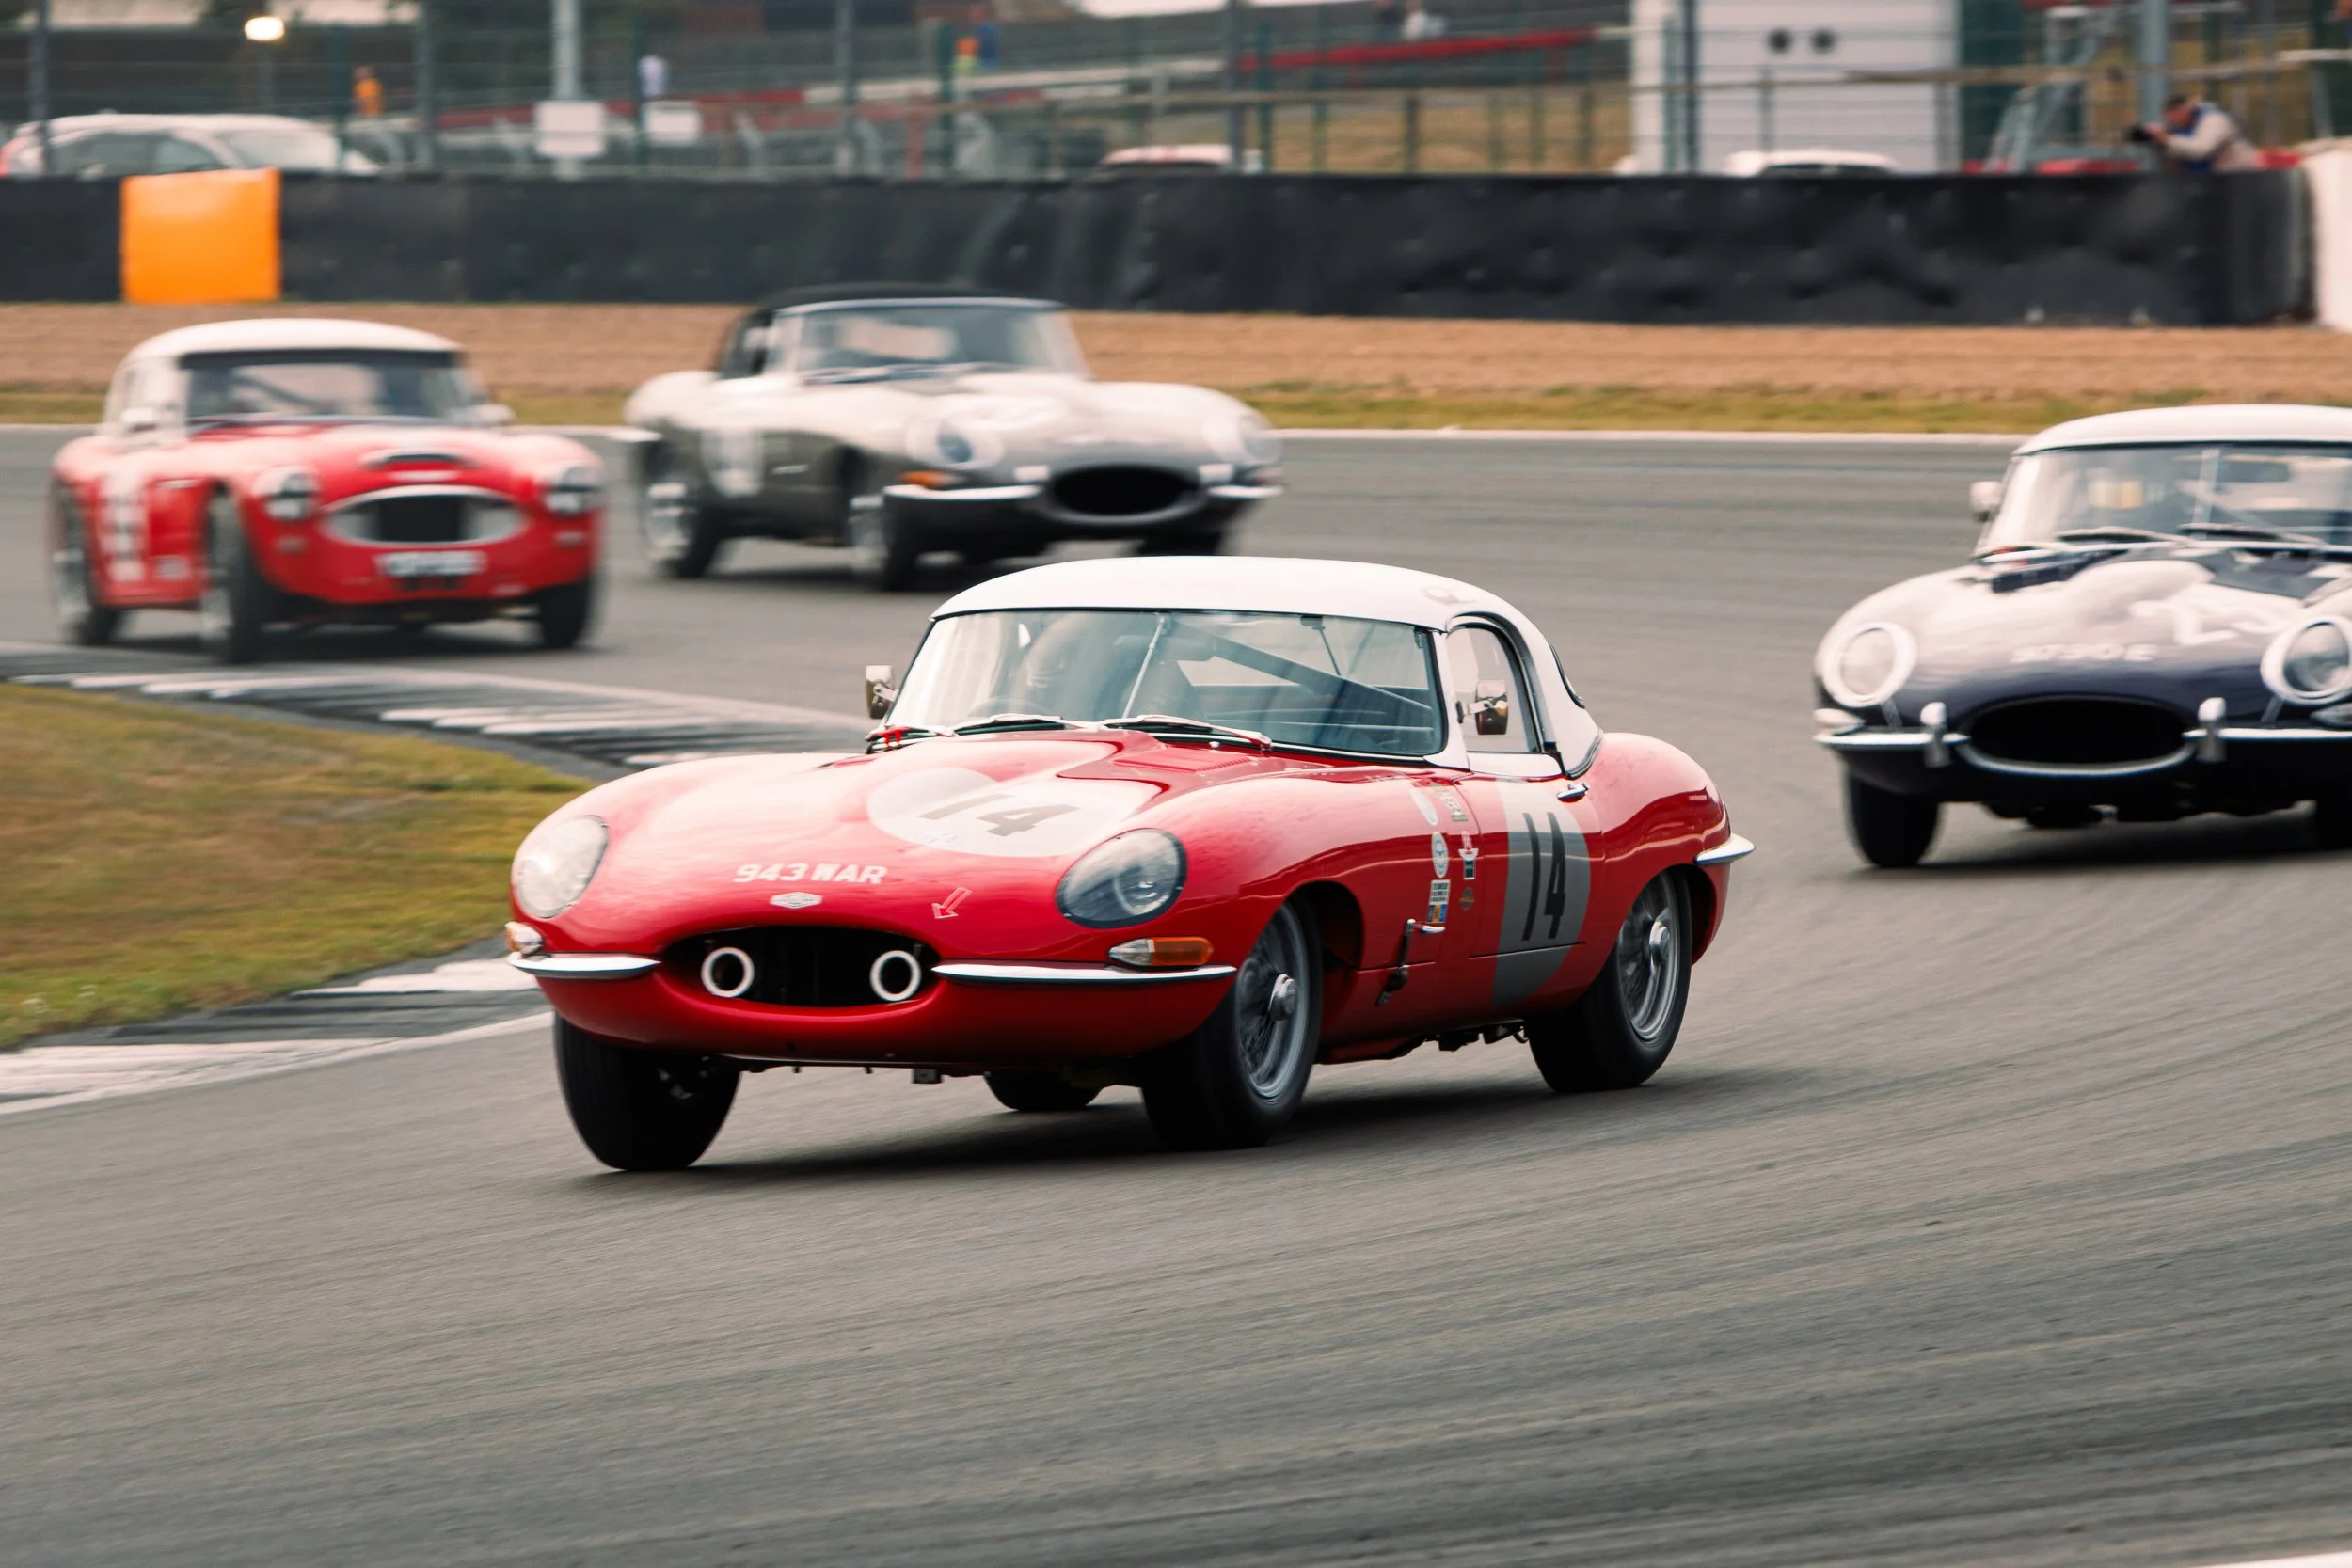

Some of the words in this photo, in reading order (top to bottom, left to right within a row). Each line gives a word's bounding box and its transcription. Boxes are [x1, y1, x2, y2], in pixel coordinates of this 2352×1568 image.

[917, 792, 1083, 837] 14
[732, 863, 809, 883] 943
[811, 863, 888, 884] WAR
[1522, 813, 1566, 940] 14
